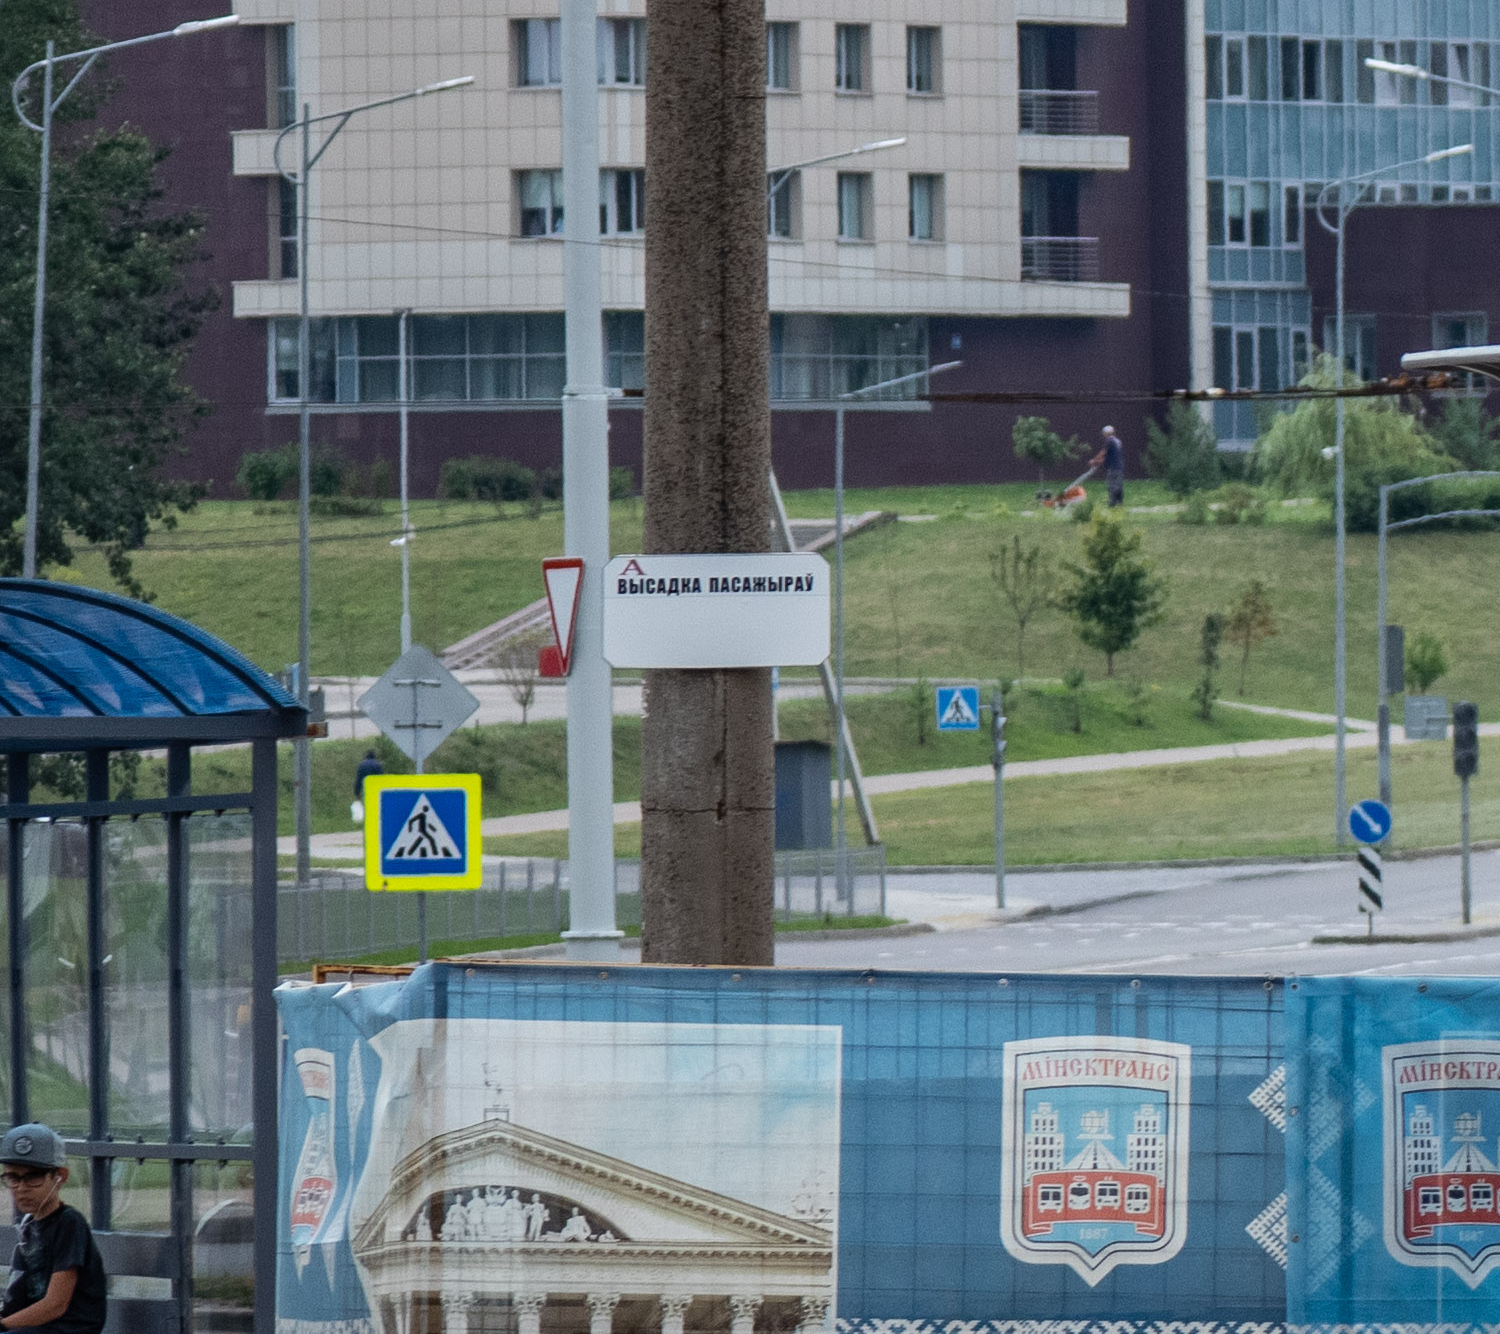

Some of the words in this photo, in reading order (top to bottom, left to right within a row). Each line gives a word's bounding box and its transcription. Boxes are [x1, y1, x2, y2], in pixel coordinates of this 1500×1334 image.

[617, 576, 703, 596] ВЫСАДКА
[709, 572, 815, 594] ПАСАЖЫРАЎ
[1022, 1056, 1170, 1082] МІНСКТРАНС
